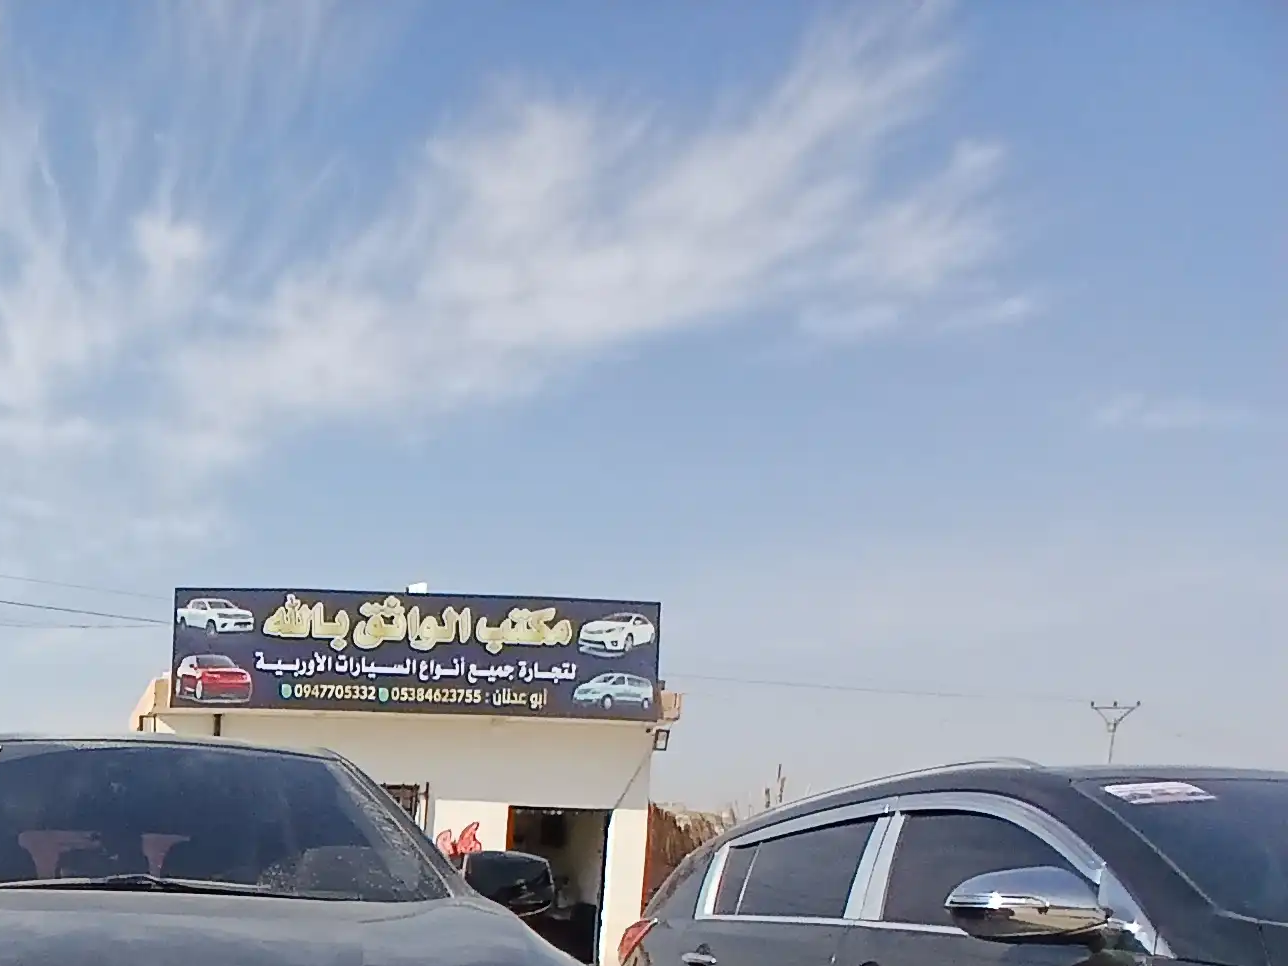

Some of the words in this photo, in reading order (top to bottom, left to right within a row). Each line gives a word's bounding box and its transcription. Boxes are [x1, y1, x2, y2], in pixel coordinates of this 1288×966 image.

[263, 593, 350, 651] بالله
[353, 595, 471, 651] الواثق
[476, 607, 572, 654] مكتب
[255, 651, 332, 677] الأوربية
[335, 654, 417, 679] السيارات
[468, 663, 515, 684] جميع
[518, 660, 577, 684] لتجارة
[294, 683, 376, 701] 0947705332
[391, 687, 482, 704] 05384623755
